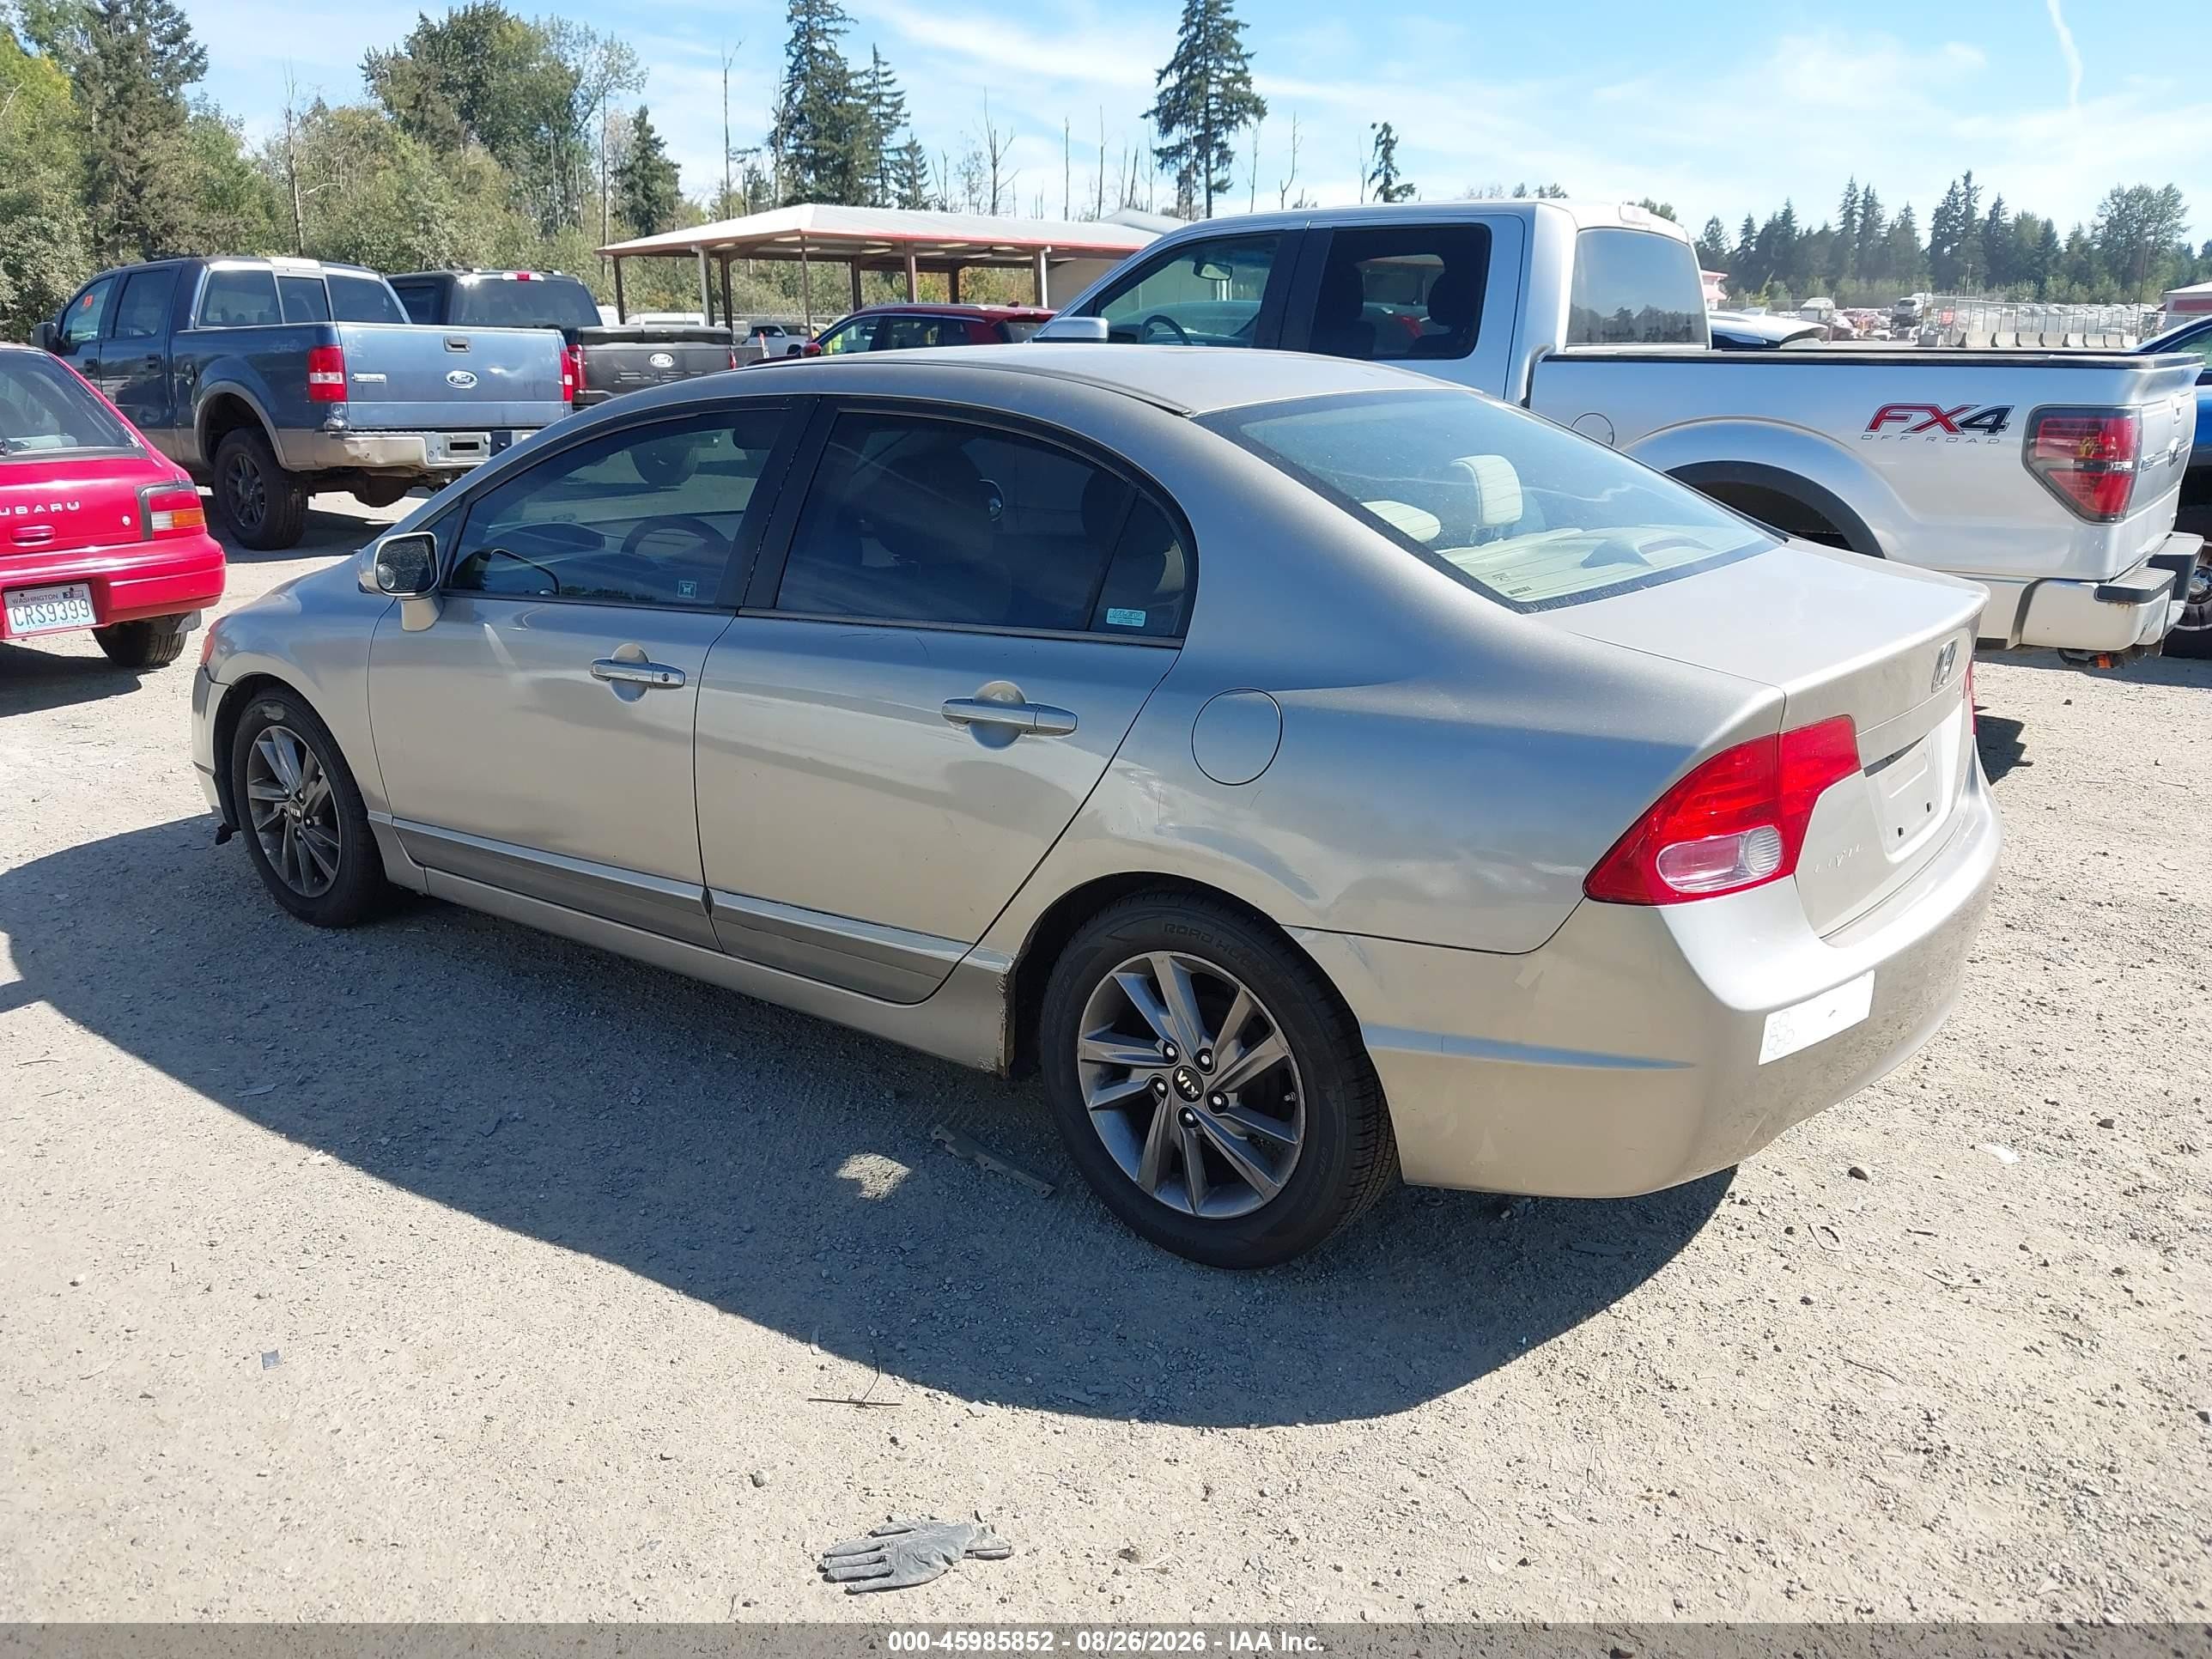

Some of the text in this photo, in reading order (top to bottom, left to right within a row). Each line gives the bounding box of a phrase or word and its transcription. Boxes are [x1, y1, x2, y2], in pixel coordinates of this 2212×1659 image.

[1865, 403, 2015, 436] FX4
[1925, 436, 2001, 445] ROAD
[12, 592, 58, 605] WASHINGTON
[13, 598, 90, 627] CRS9399
[1177, 1069, 1200, 1099] KIA
